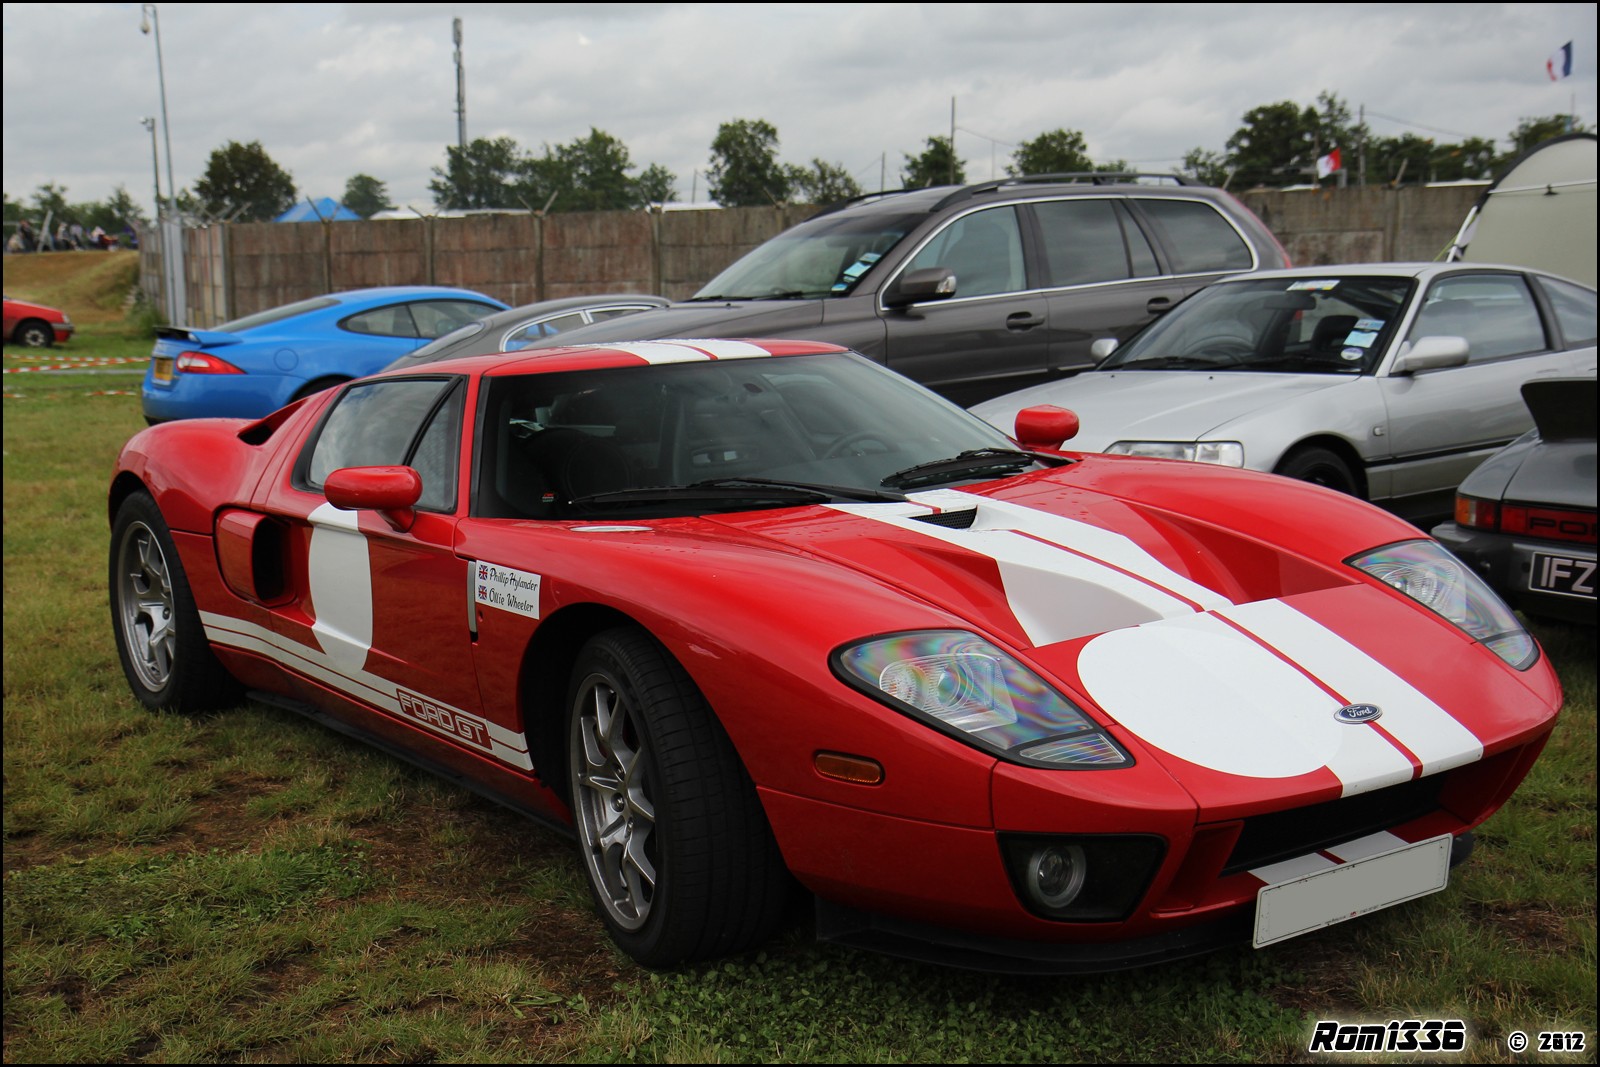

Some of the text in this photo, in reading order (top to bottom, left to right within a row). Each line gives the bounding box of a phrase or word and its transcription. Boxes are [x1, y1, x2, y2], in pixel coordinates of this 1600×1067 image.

[1530, 517, 1597, 536] PO
[490, 567, 538, 592] Phillip Hylander
[489, 587, 534, 612] Ollie Wheeler
[398, 691, 484, 744] FORD GT
[1346, 706, 1373, 718] Ford
